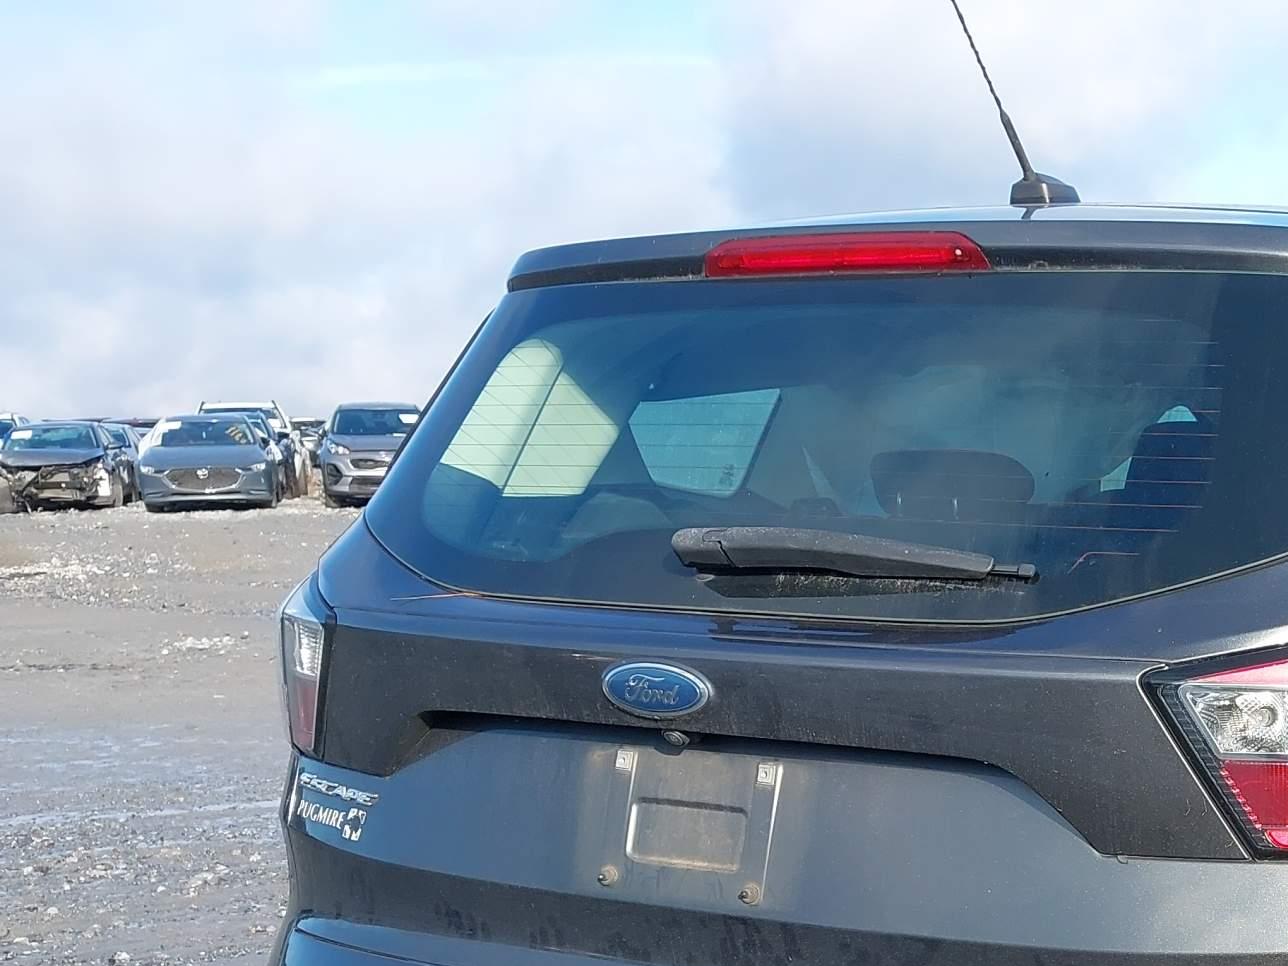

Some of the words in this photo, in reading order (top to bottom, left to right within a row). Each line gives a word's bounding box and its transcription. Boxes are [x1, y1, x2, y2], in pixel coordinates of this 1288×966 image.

[624, 673, 681, 705] Ford
[299, 772, 379, 806] ESCAPE
[296, 799, 346, 829] PUGMIRE
